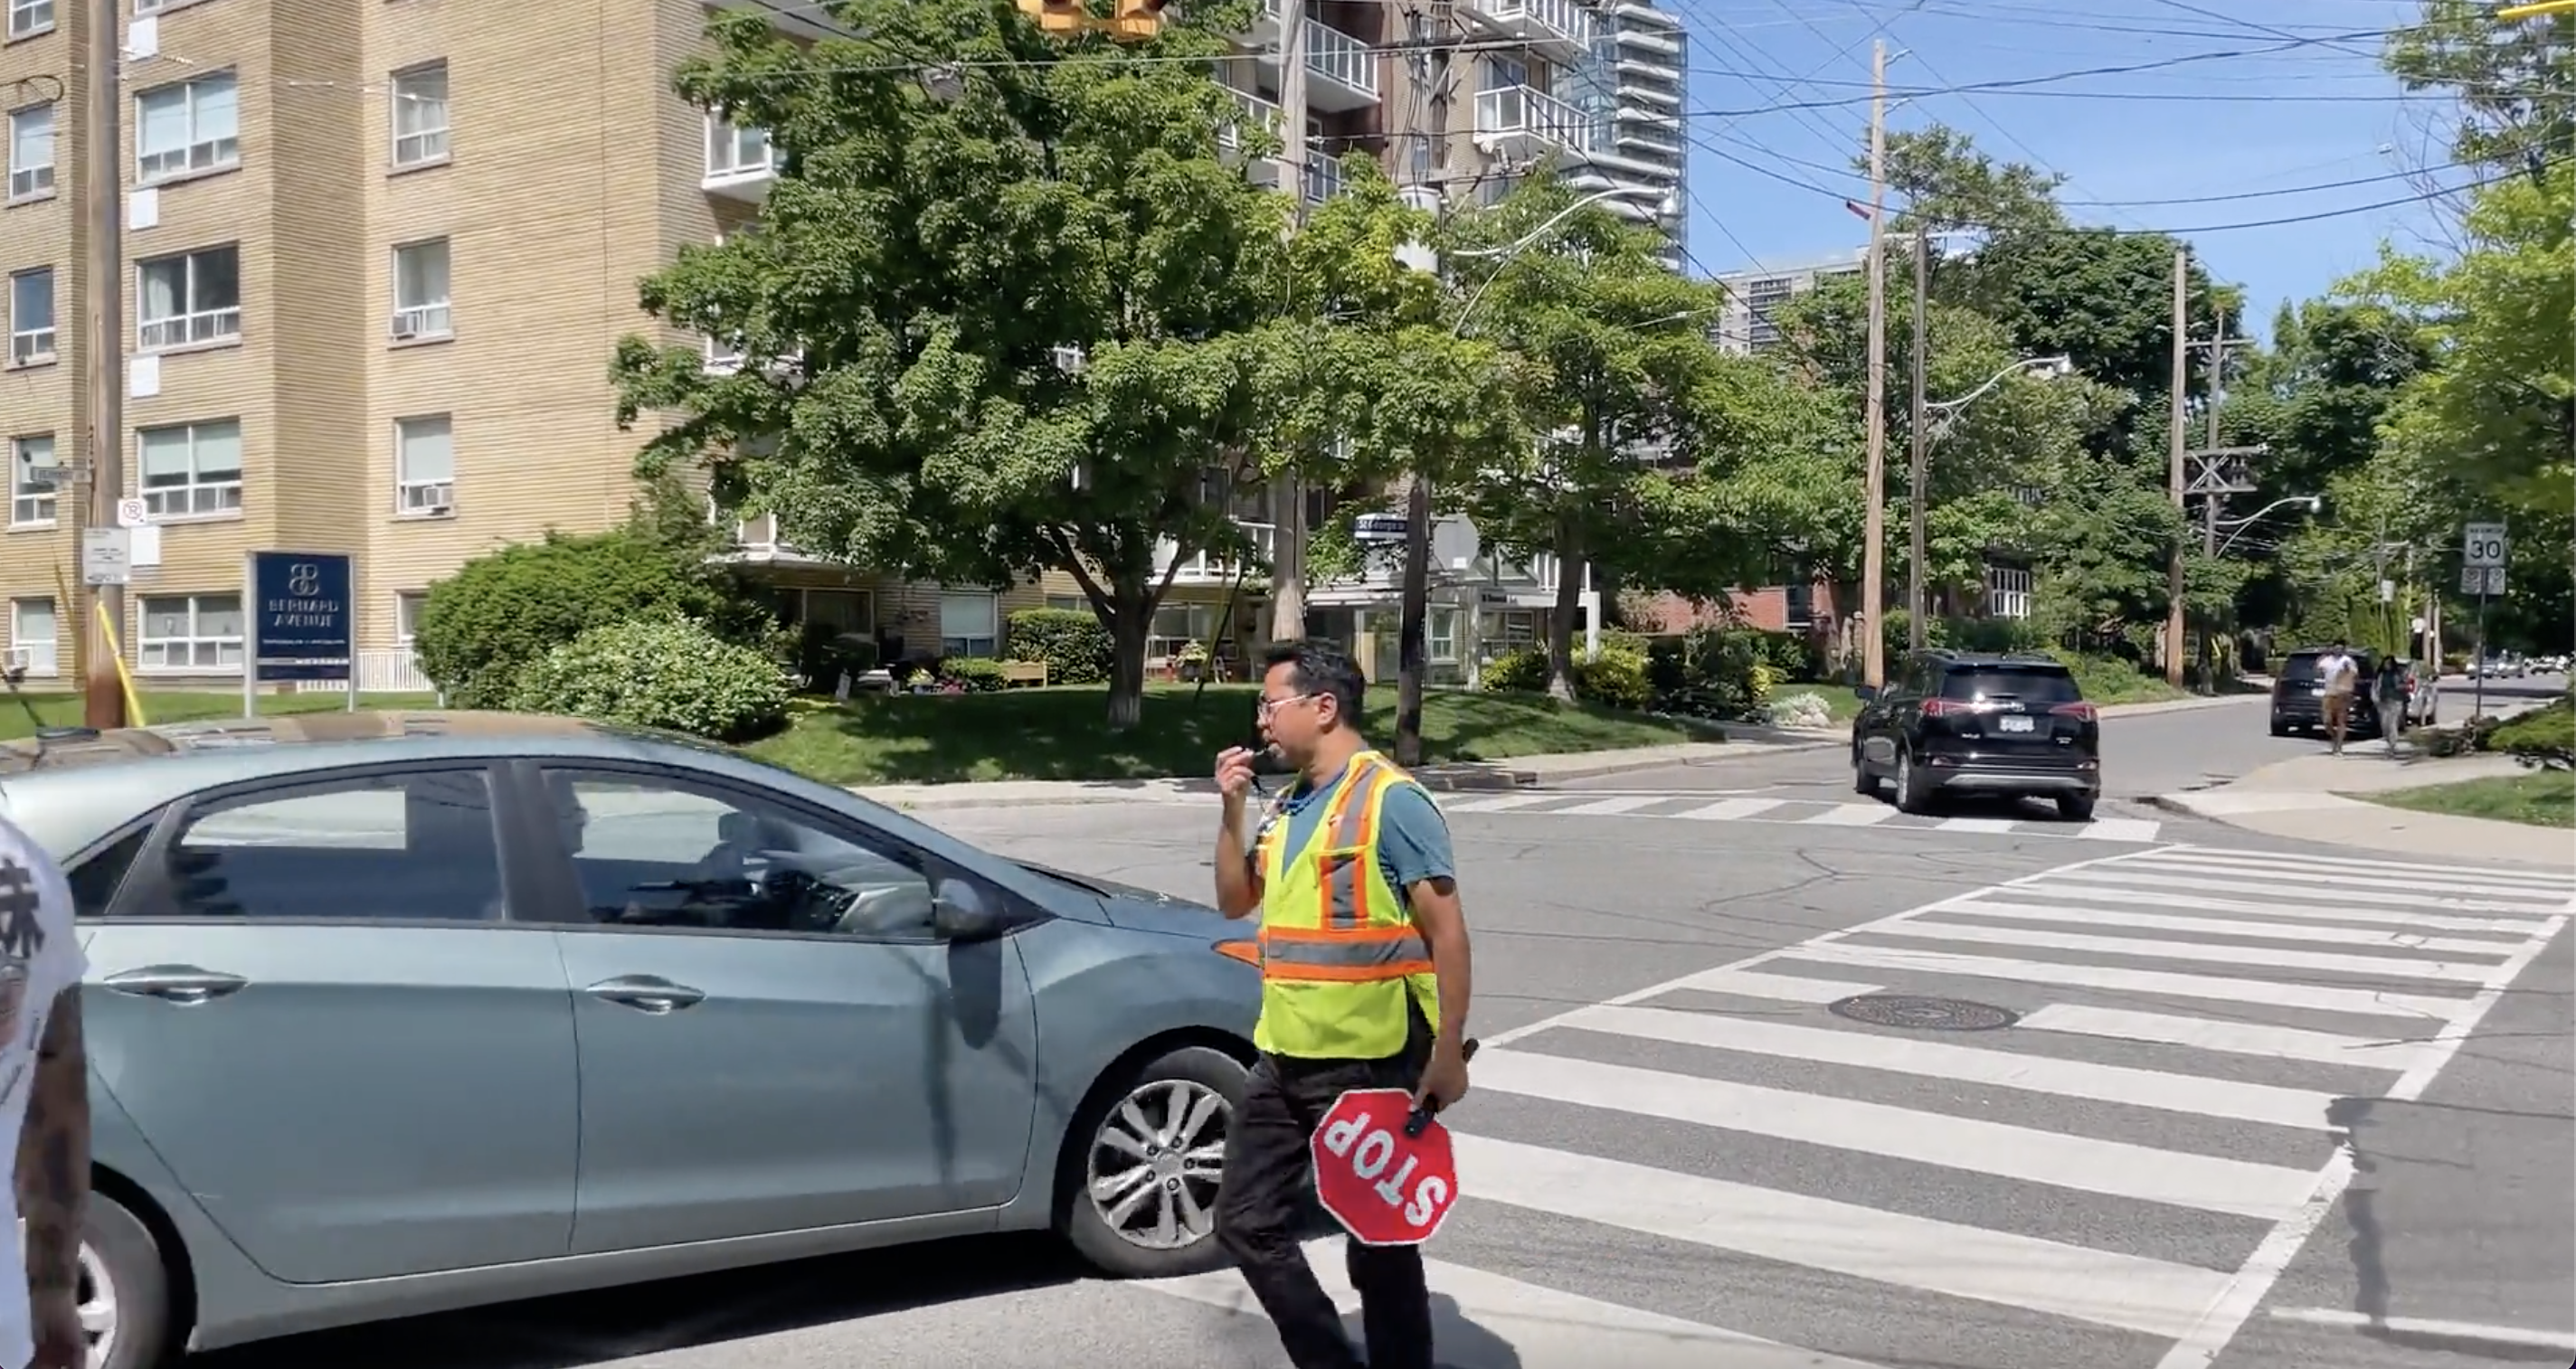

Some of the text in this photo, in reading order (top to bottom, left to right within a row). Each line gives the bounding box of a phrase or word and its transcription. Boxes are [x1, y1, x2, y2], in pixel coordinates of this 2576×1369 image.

[2470, 540, 2500, 559] 30
[269, 599, 339, 612] BERNARD
[273, 614, 335, 628] AVENUE
[1323, 1111, 1447, 1227] STOP
